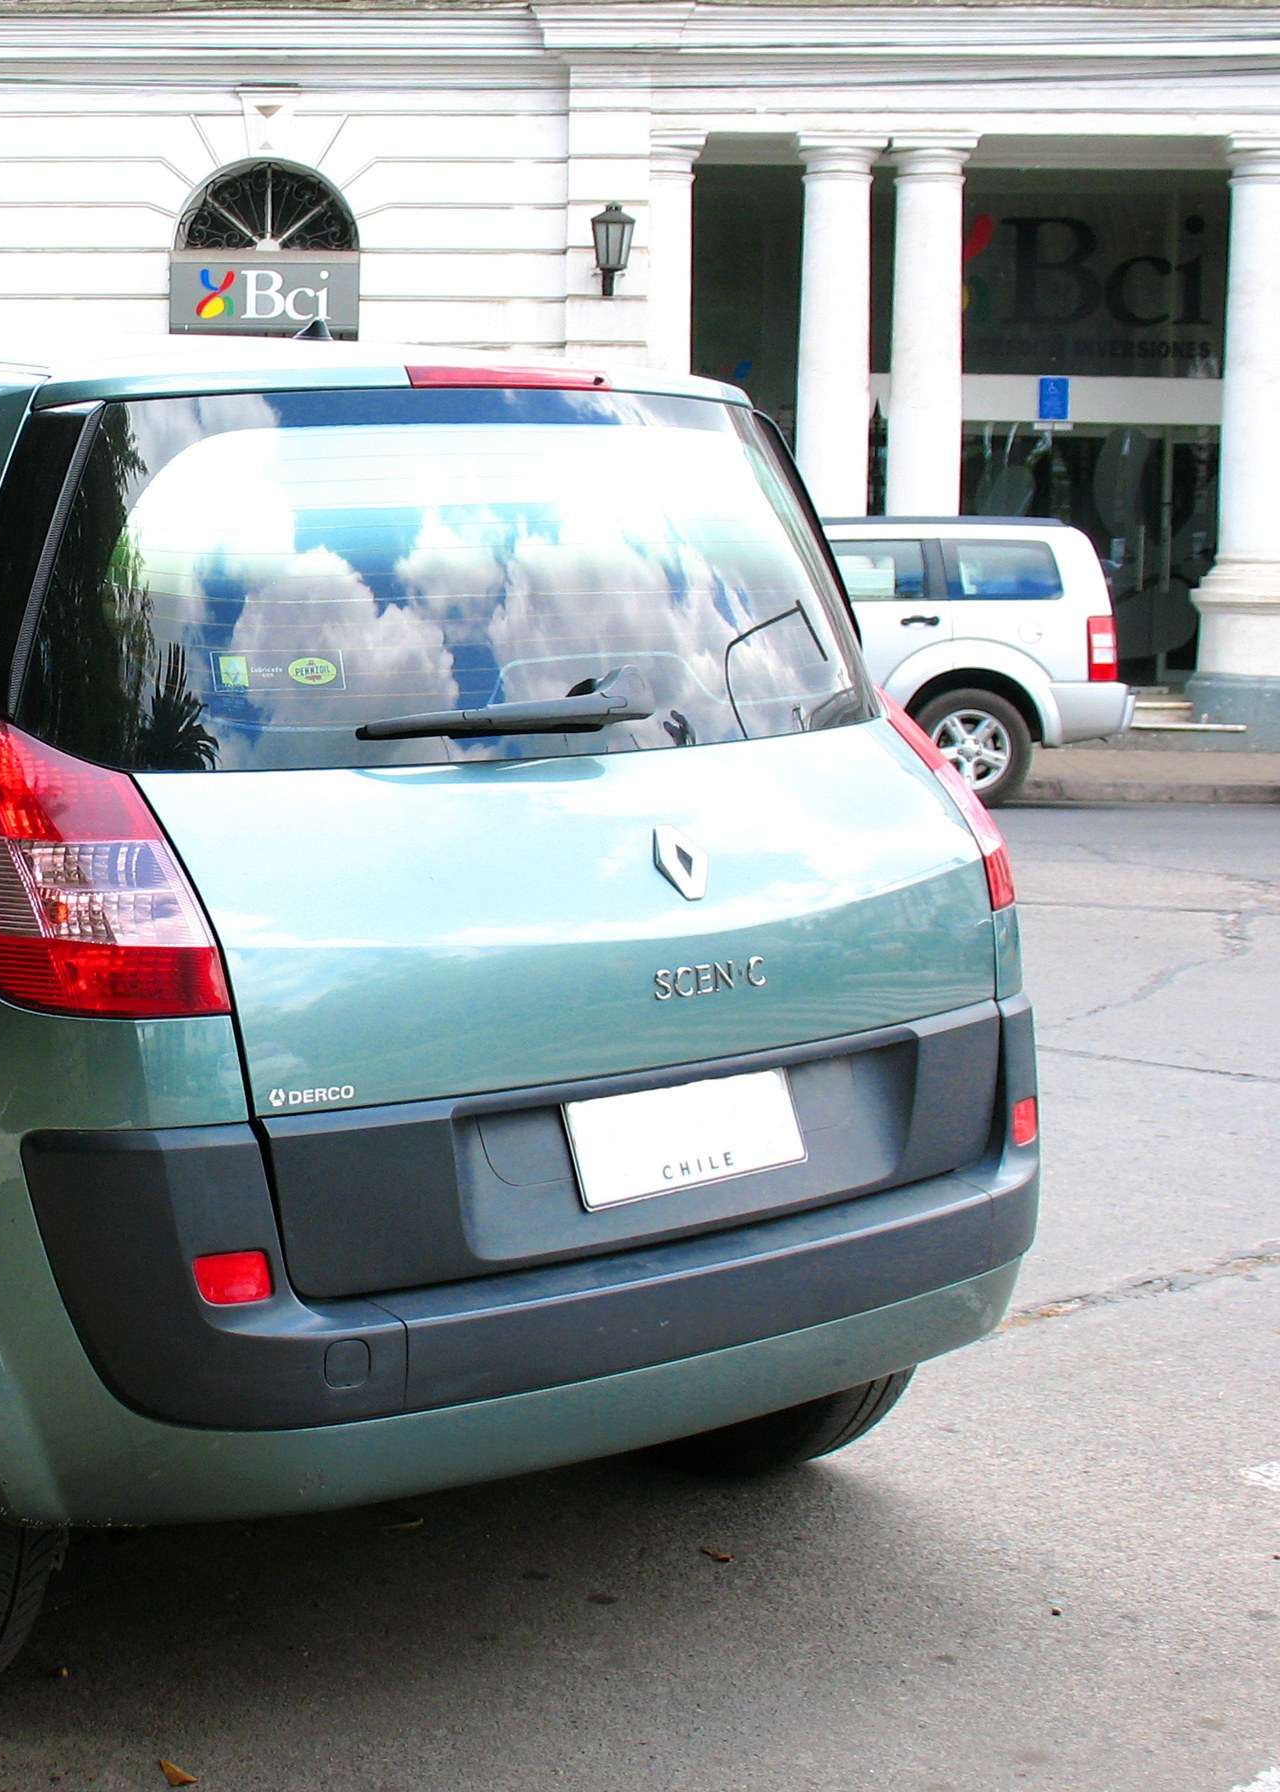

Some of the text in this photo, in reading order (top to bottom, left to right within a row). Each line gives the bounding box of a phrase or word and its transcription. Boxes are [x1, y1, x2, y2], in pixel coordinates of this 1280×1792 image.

[1001, 214, 1212, 326] Bci
[240, 269, 332, 320] Bci
[654, 956, 767, 1001] SCENC
[288, 1085, 355, 1105] DERCO
[662, 1151, 734, 1180] CHILE
